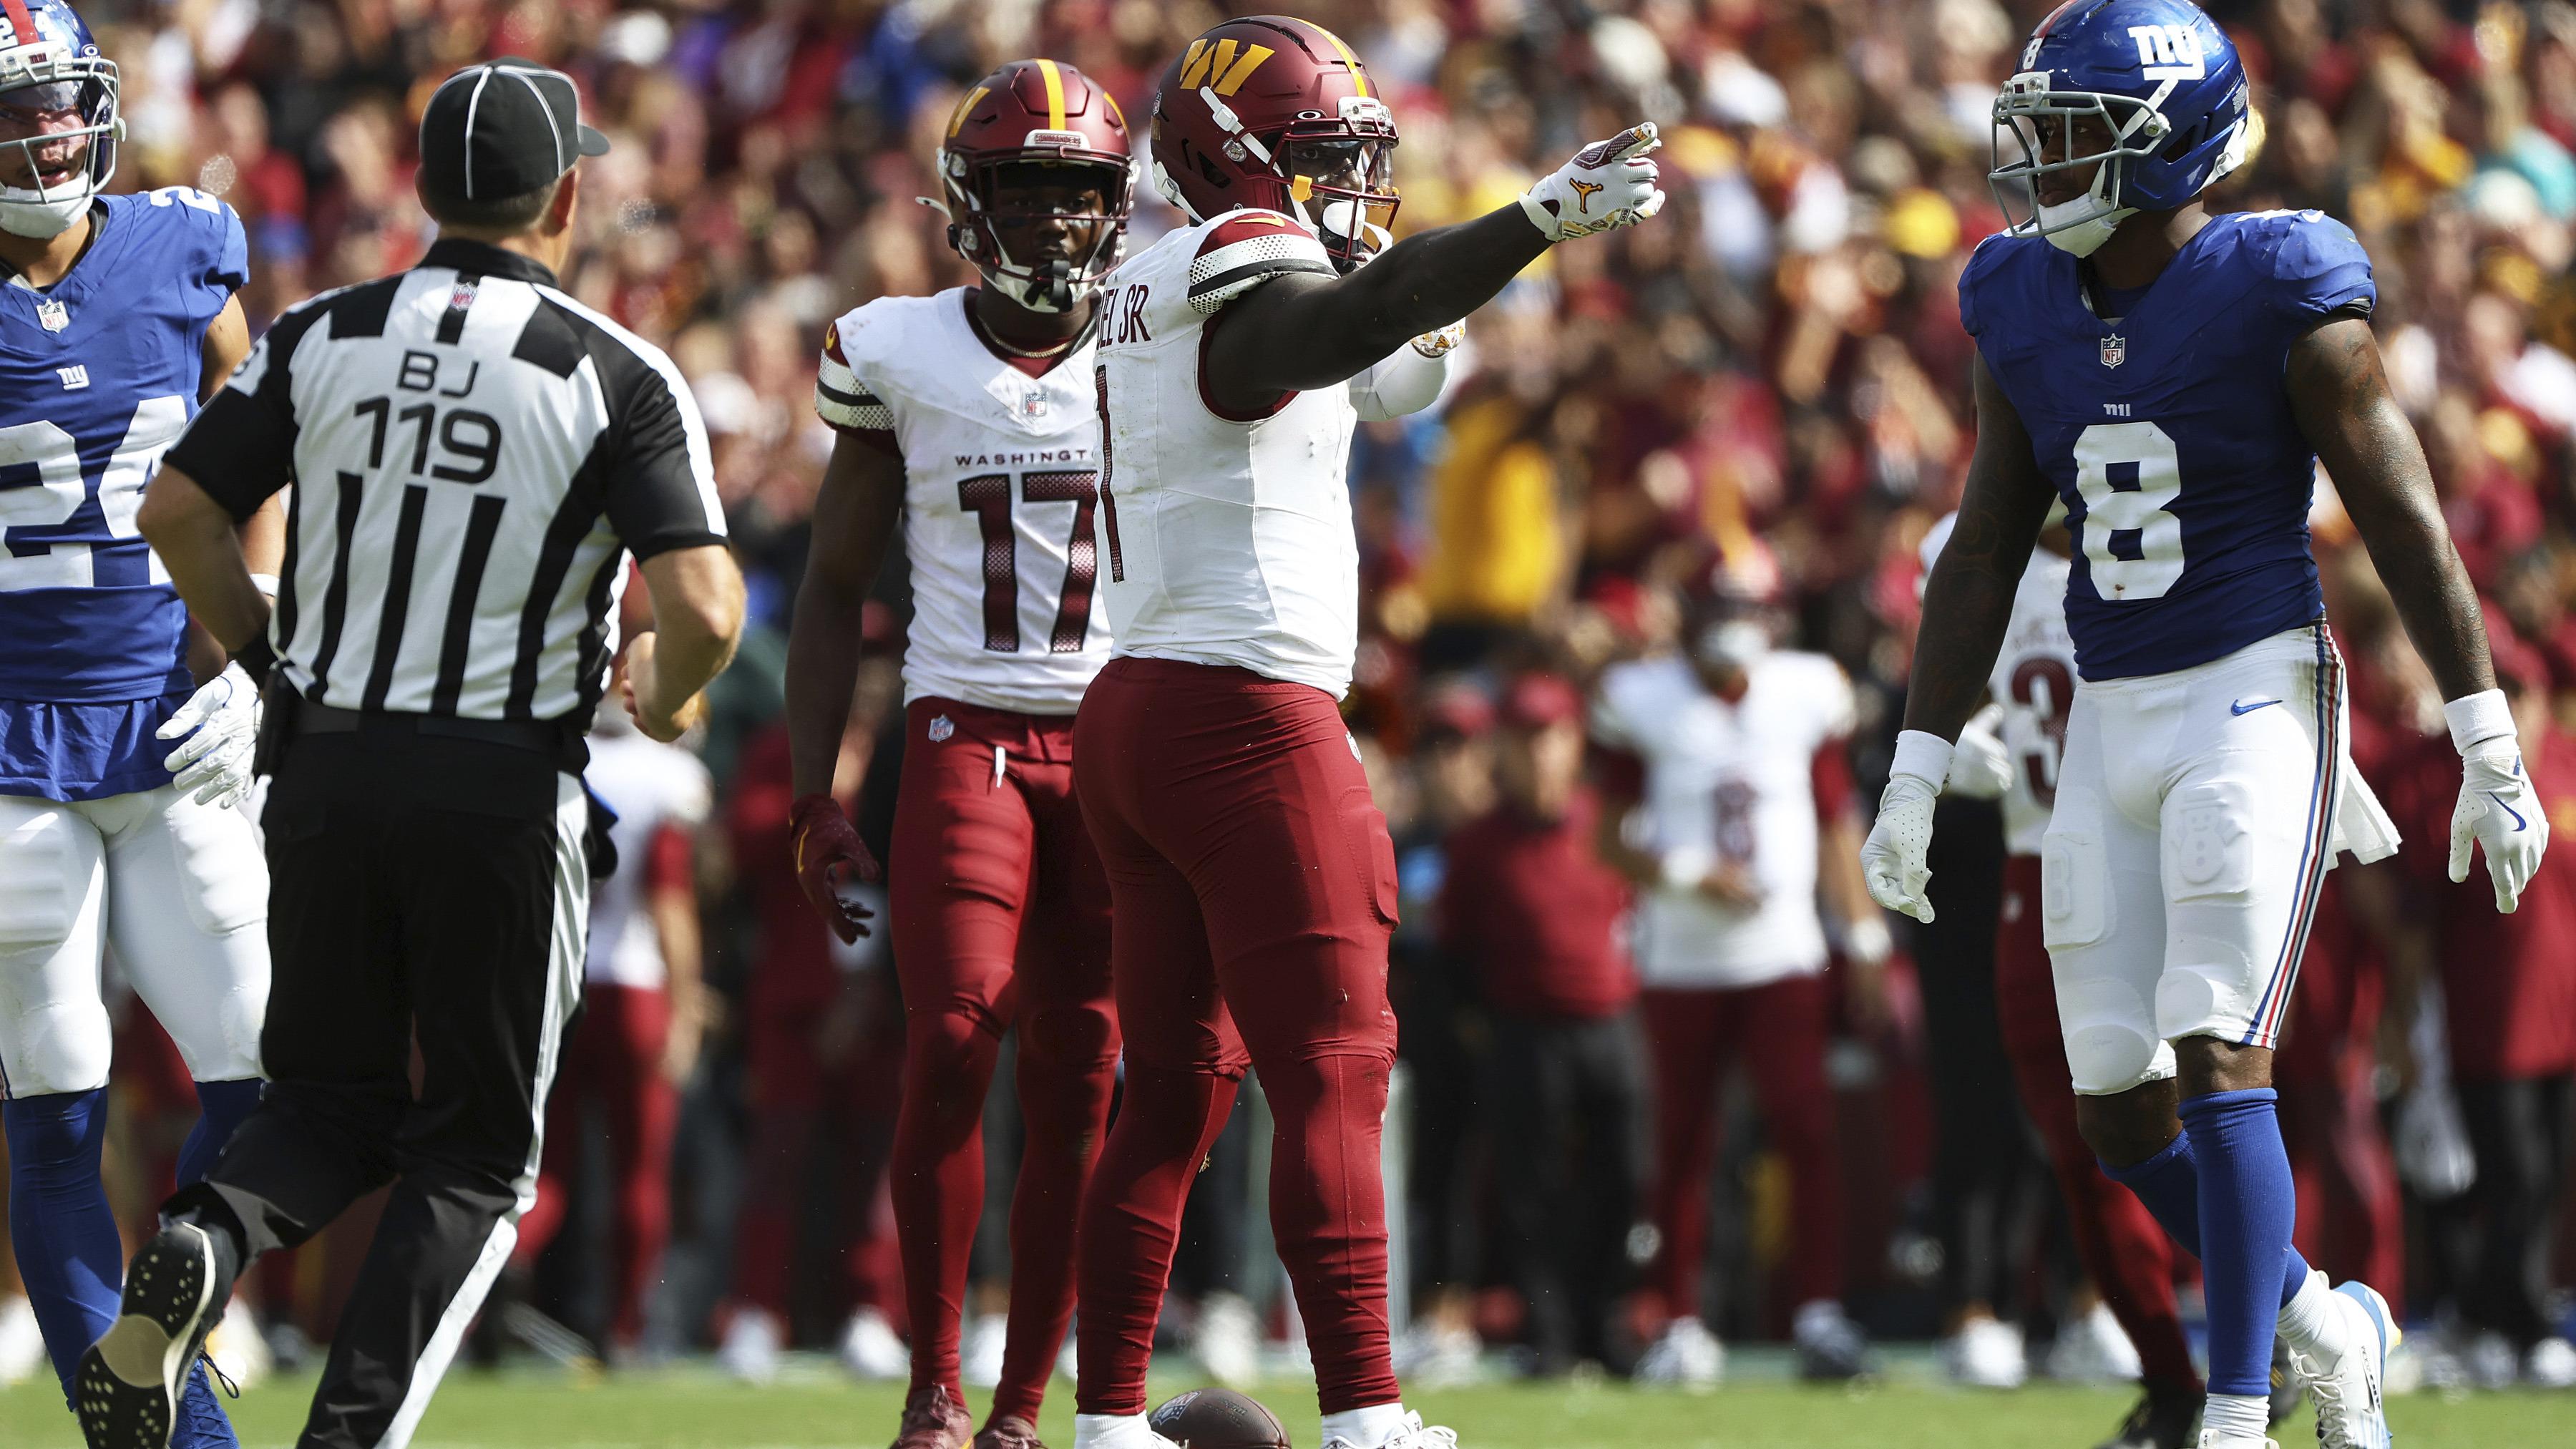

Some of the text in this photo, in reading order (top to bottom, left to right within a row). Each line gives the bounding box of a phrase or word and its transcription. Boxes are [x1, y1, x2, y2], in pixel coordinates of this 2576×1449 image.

[2023, 38, 2043, 69] 8
[1118, 283, 1151, 343] SR
[397, 349, 479, 399] BJ
[2104, 349, 2122, 363] NFL
[1027, 400, 1045, 413] NFL
[353, 394, 502, 484] 119
[955, 449, 1095, 466] WASHINGT
[2073, 421, 2184, 600] 8
[957, 469, 1098, 654] 17
